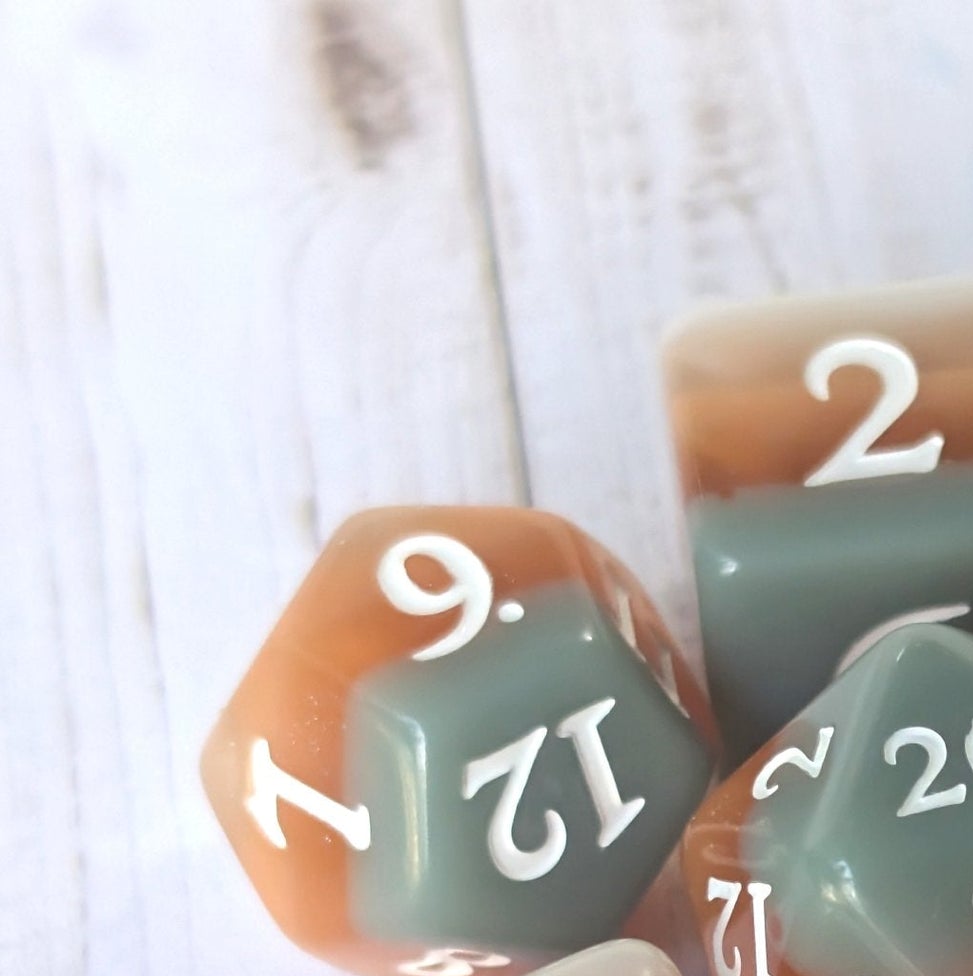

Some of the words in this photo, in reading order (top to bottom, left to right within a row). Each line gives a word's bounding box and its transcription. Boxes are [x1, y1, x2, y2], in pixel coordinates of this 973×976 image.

[804, 338, 945, 487] 2
[461, 697, 645, 881] 12
[751, 726, 835, 800] 2
